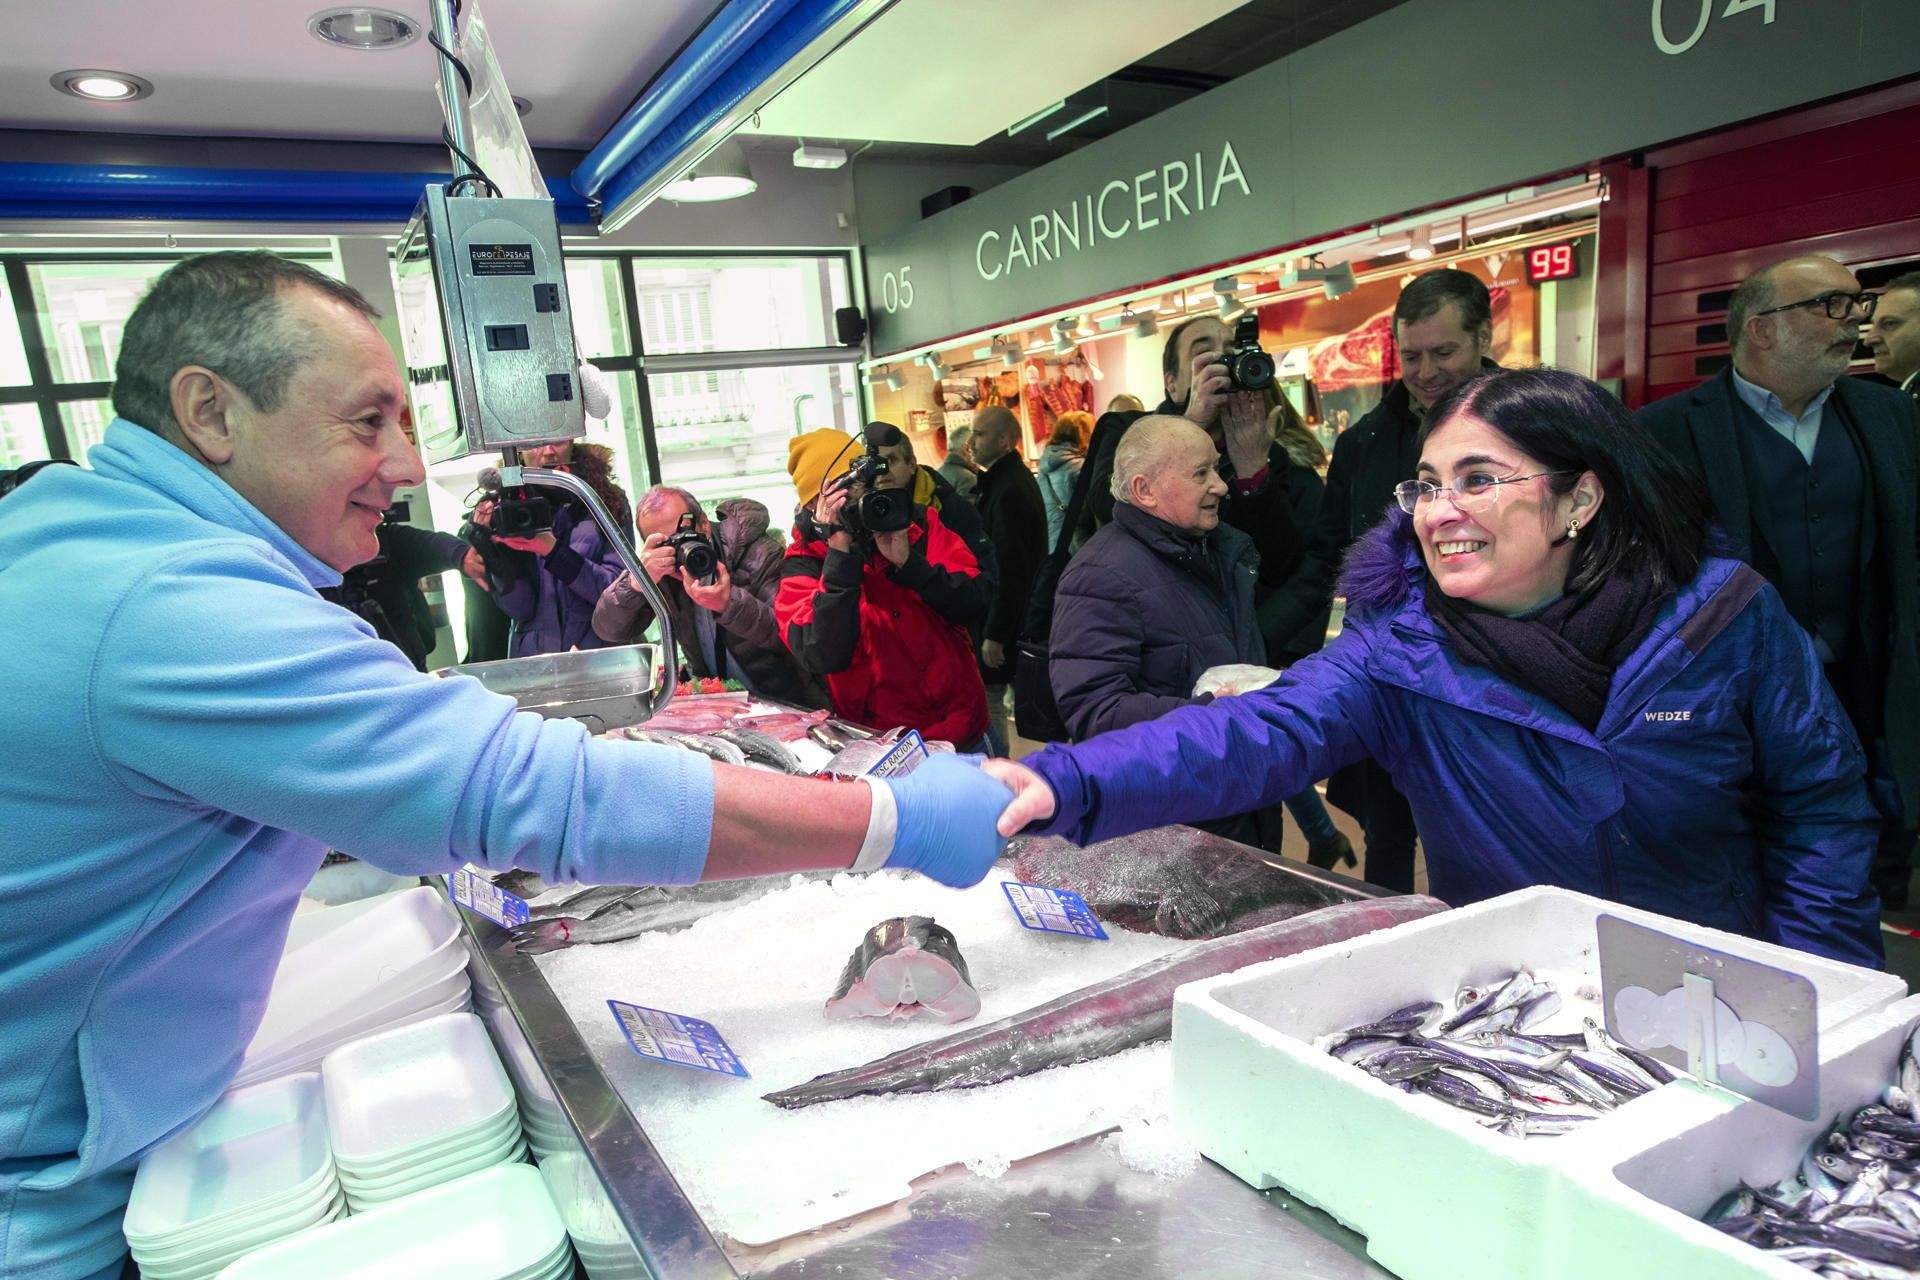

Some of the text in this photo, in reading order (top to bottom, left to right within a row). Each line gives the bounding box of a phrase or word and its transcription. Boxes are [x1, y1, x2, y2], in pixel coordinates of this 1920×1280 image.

[976, 141, 1251, 281] CARNICERIA
[1532, 245, 1571, 279] 99
[883, 266, 914, 313] 05
[1645, 711, 1691, 721] WEDZE
